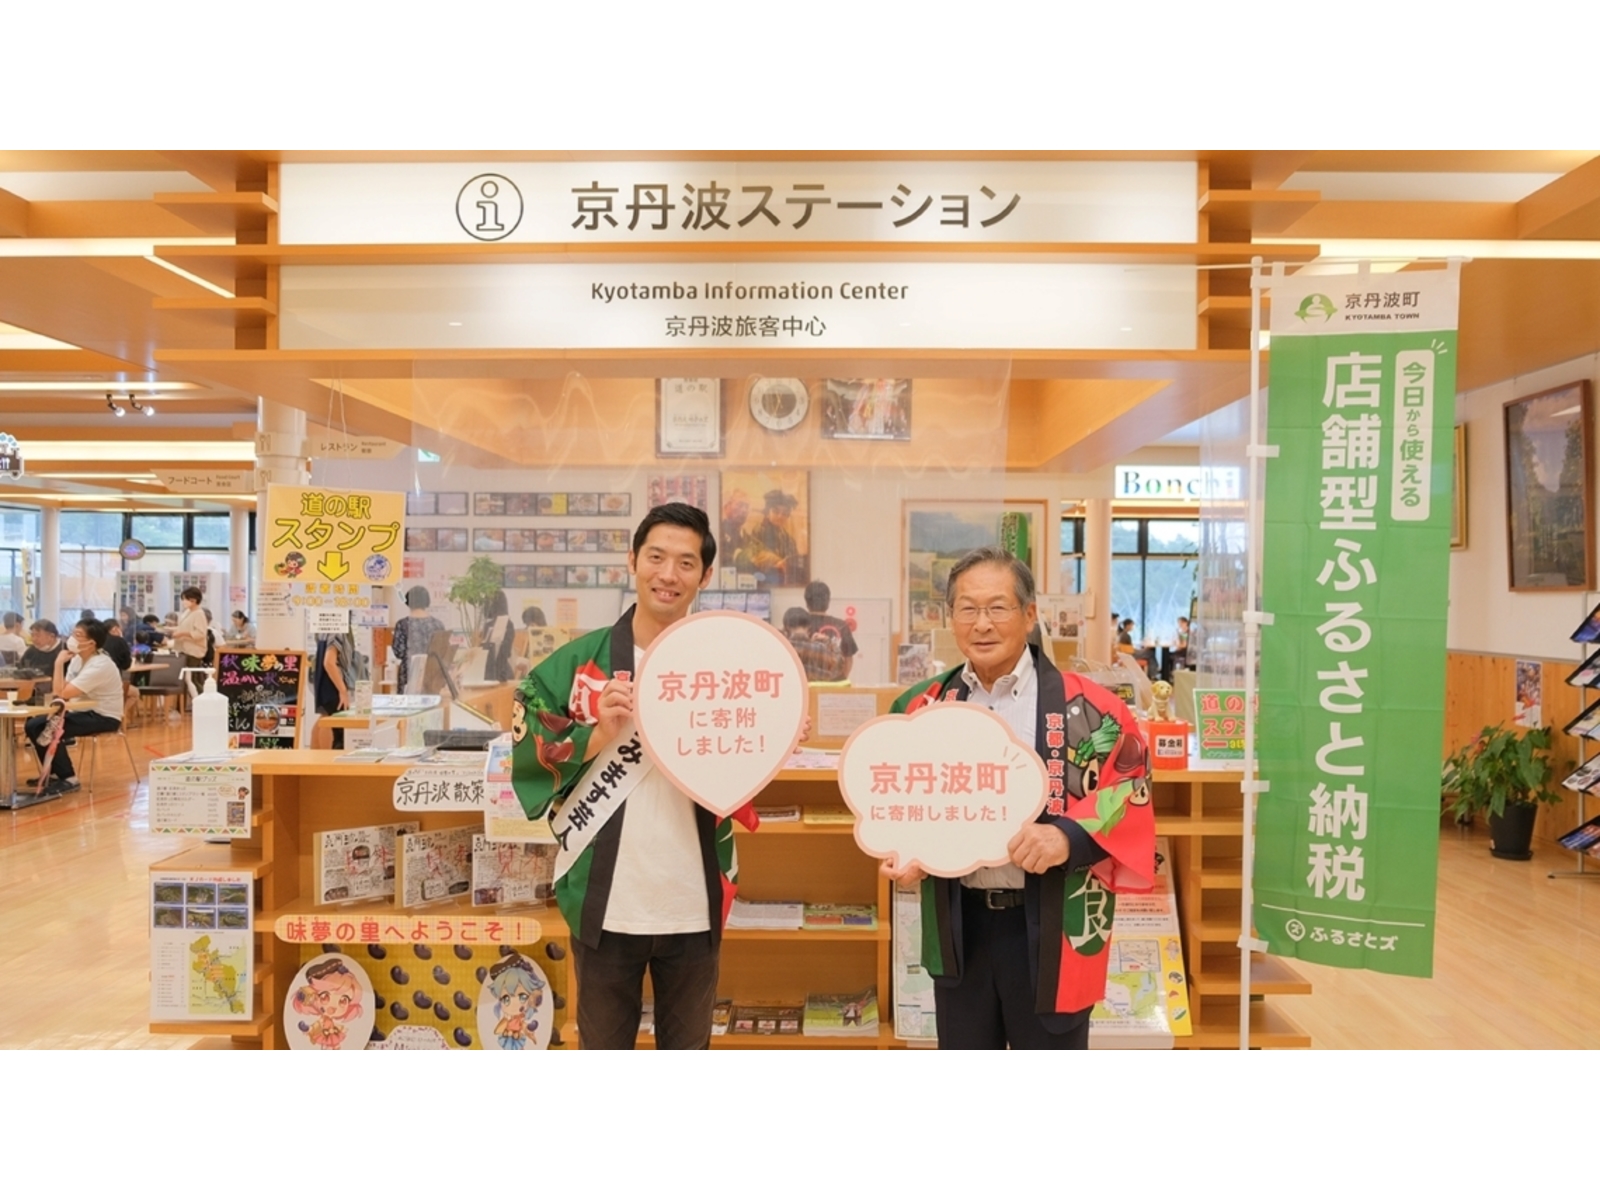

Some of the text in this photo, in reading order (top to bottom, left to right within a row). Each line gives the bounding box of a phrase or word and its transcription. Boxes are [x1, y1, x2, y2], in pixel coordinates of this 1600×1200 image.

[571, 181, 1021, 231] 京丹波ステーション
[591, 281, 909, 304] Kyotamba Information Center
[1345, 291, 1421, 309] 京丹波町
[665, 315, 827, 338] 京丹波旅客中心
[1345, 312, 1420, 321] KYOTAMBA TOWN
[1399, 361, 1427, 508] 今日から使える
[1123, 471, 1234, 495] Bonchi
[300, 491, 371, 520] 道の駅
[272, 517, 401, 553] スタンプ
[1305, 351, 1382, 901] 店舗型ふるさと納税
[657, 669, 784, 702] 京丹波町
[690, 707, 757, 729] に寄附
[677, 735, 765, 756] しました！
[1045, 713, 1065, 816] 京都・京丹波
[558, 730, 644, 851] みます芸人
[869, 762, 1010, 795] 京丹波町
[870, 805, 1008, 822] に寄附しました！
[287, 920, 522, 942] 味夢の里へようこそ！
[1309, 926, 1399, 951] ふるさとズ
